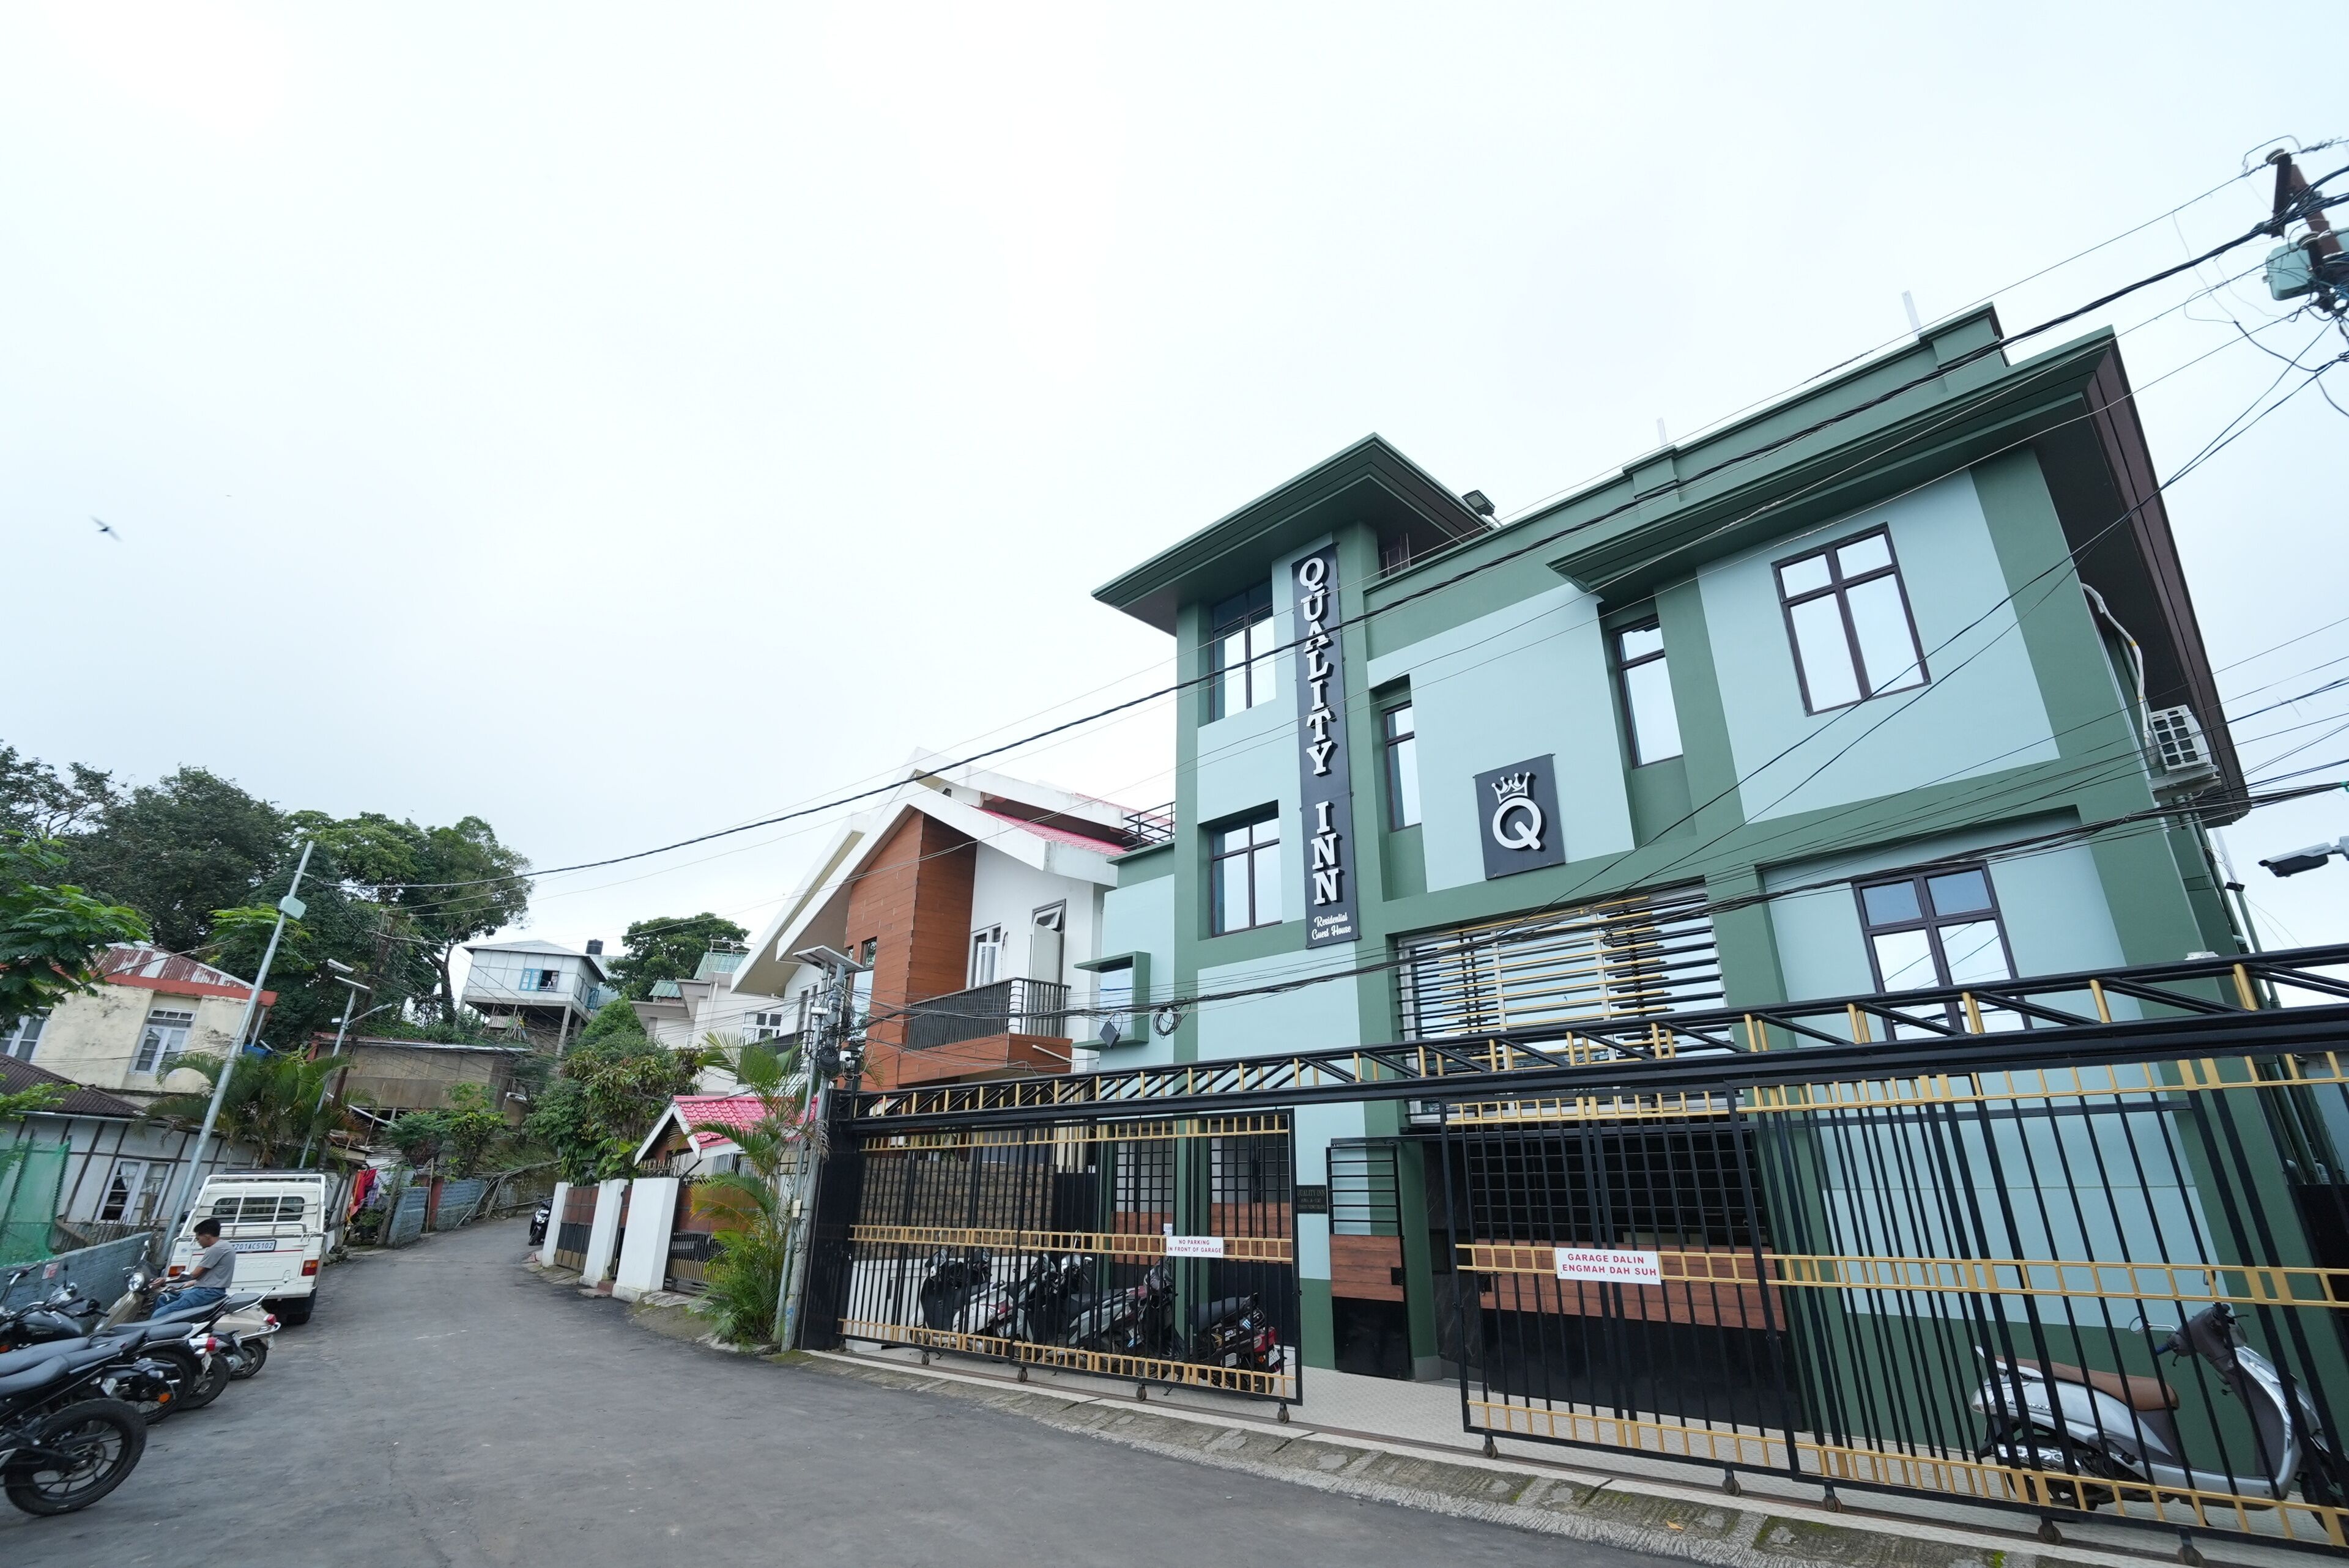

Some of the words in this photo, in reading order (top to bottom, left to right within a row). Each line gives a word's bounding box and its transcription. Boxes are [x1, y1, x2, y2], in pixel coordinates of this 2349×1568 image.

[1299, 557, 1333, 775] QUALITY
[1492, 797, 1542, 849] Q
[1310, 800, 1339, 905] INN
[1313, 912, 1348, 928] Residential
[1312, 928, 1329, 940] Guest
[1330, 925, 1352, 936] House
[1567, 1253, 1609, 1262] GARAGE
[1613, 1256, 1644, 1264] DALIN
[1562, 1264, 1605, 1273] ENGMAH
